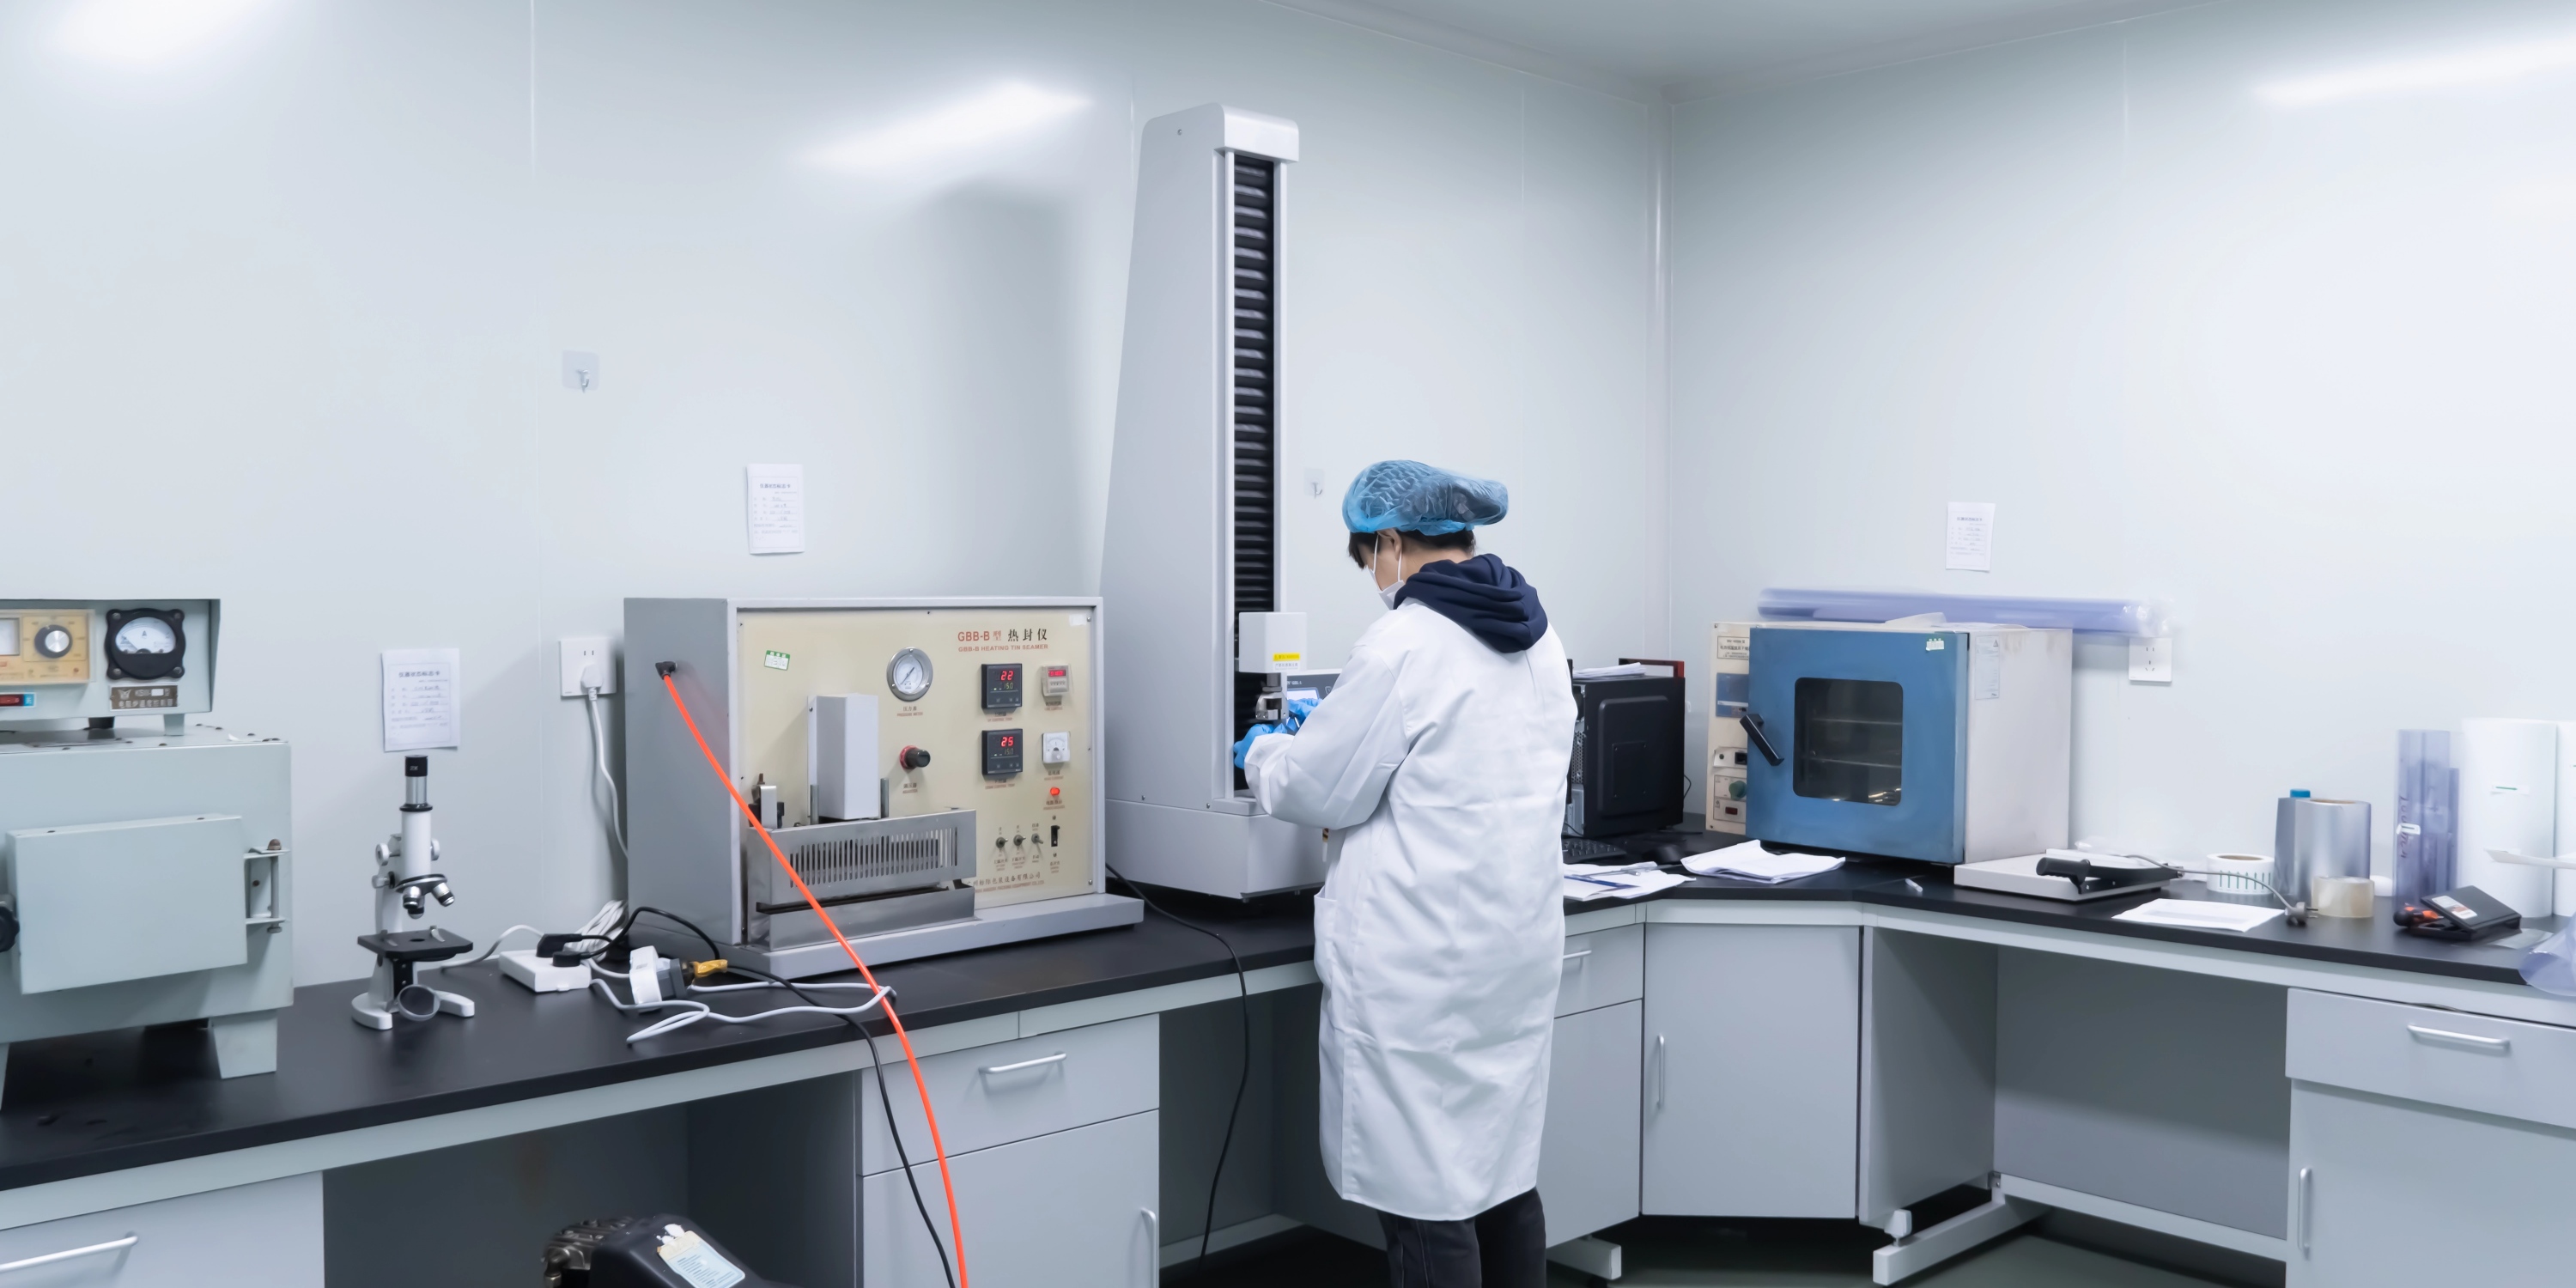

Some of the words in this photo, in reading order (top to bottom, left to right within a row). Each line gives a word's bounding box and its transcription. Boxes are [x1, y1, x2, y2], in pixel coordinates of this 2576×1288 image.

[957, 631, 991, 641] GBB-B
[1007, 628, 1048, 641] 热封仪
[1000, 671, 1014, 681] 22
[1000, 736, 1014, 747] 25
